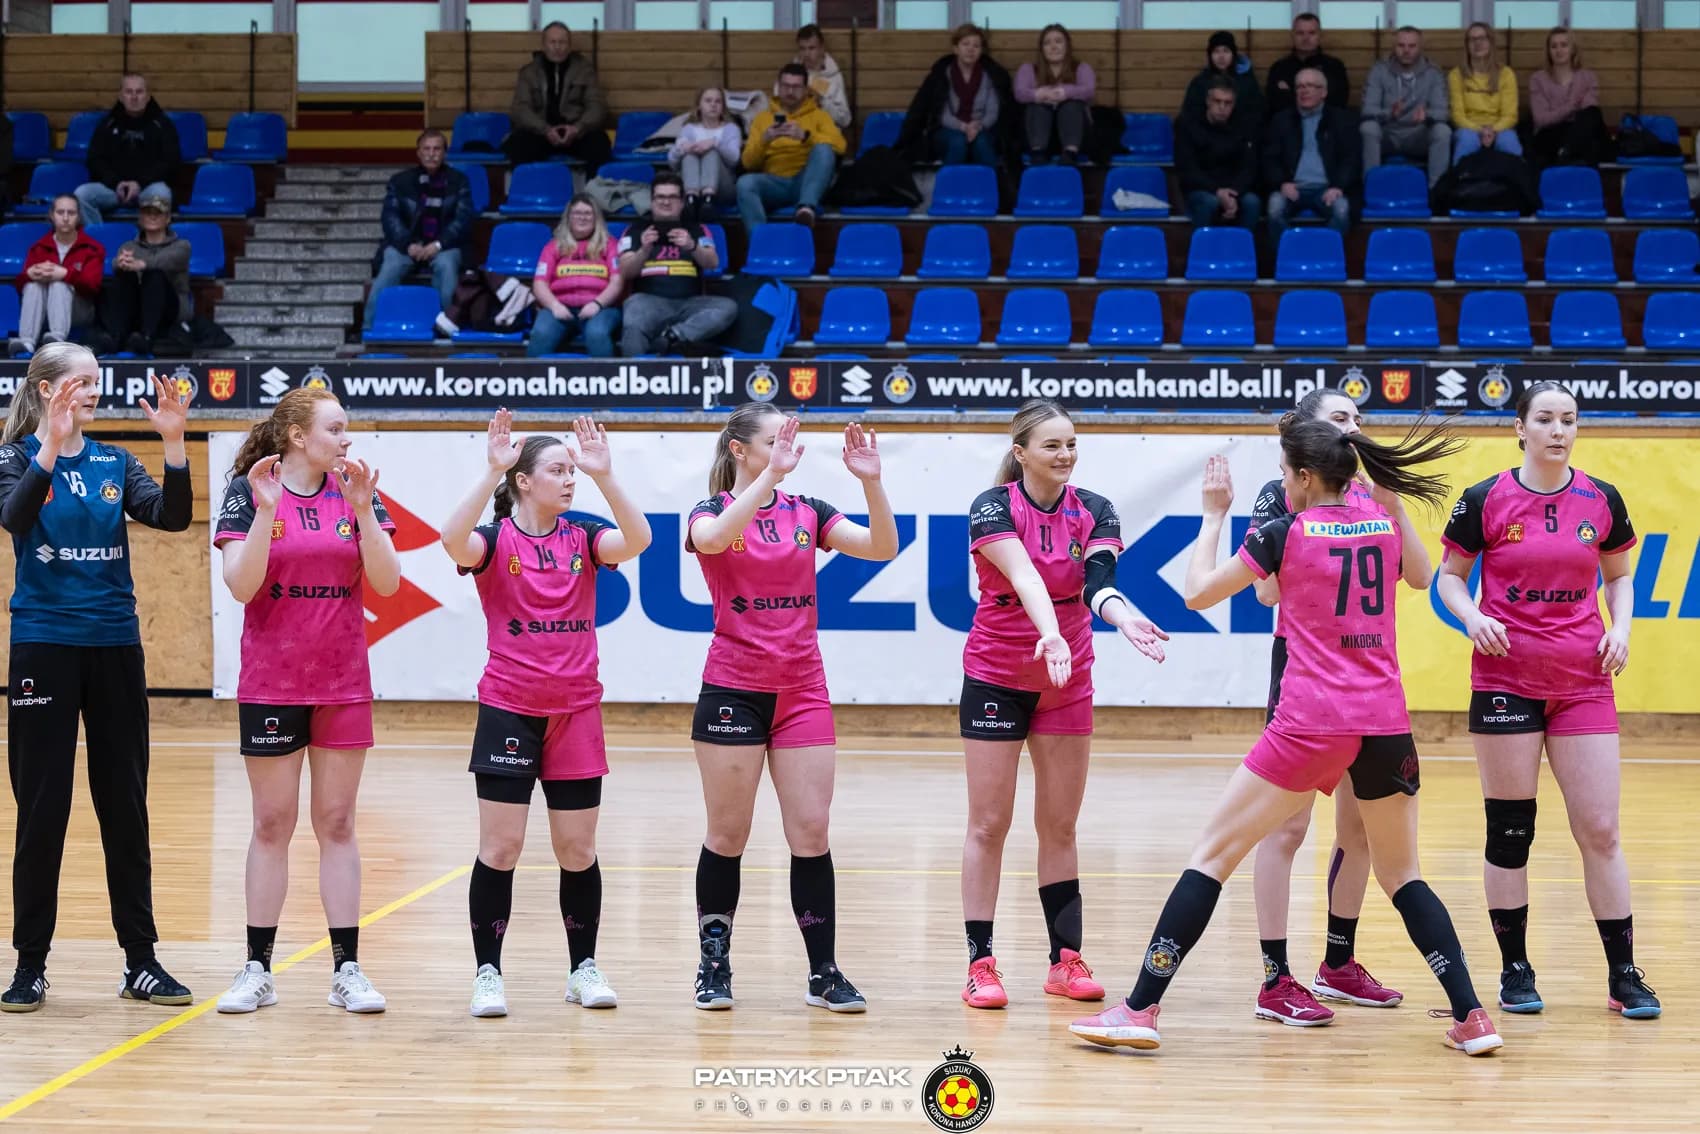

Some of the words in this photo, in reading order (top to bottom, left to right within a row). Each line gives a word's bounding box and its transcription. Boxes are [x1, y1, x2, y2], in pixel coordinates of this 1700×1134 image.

[343, 358, 733, 408] www.koronahandball.pl
[927, 368, 1325, 406] www.koronahandball.pl
[62, 471, 87, 497] 16
[296, 507, 321, 531] 15
[1544, 504, 1559, 533] 5
[756, 519, 781, 543] 13
[1328, 521, 1390, 535] LEWIATAN
[59, 546, 123, 561] SUZUKI
[534, 545, 558, 570] 14
[557, 510, 1274, 634] UZKI
[1329, 545, 1385, 617] 79
[288, 586, 351, 598] SUZUK
[1526, 587, 1587, 602] SUZUKI
[753, 595, 815, 610] SUZUKI
[528, 620, 591, 633] SUZUKI
[1341, 634, 1382, 649] MIKOCKA
[12, 697, 47, 706] karabela
[972, 719, 1012, 729] karabela
[1483, 714, 1524, 723] karabela
[707, 723, 747, 734] karabela
[251, 735, 293, 744] karabela
[490, 754, 529, 766] karabela
